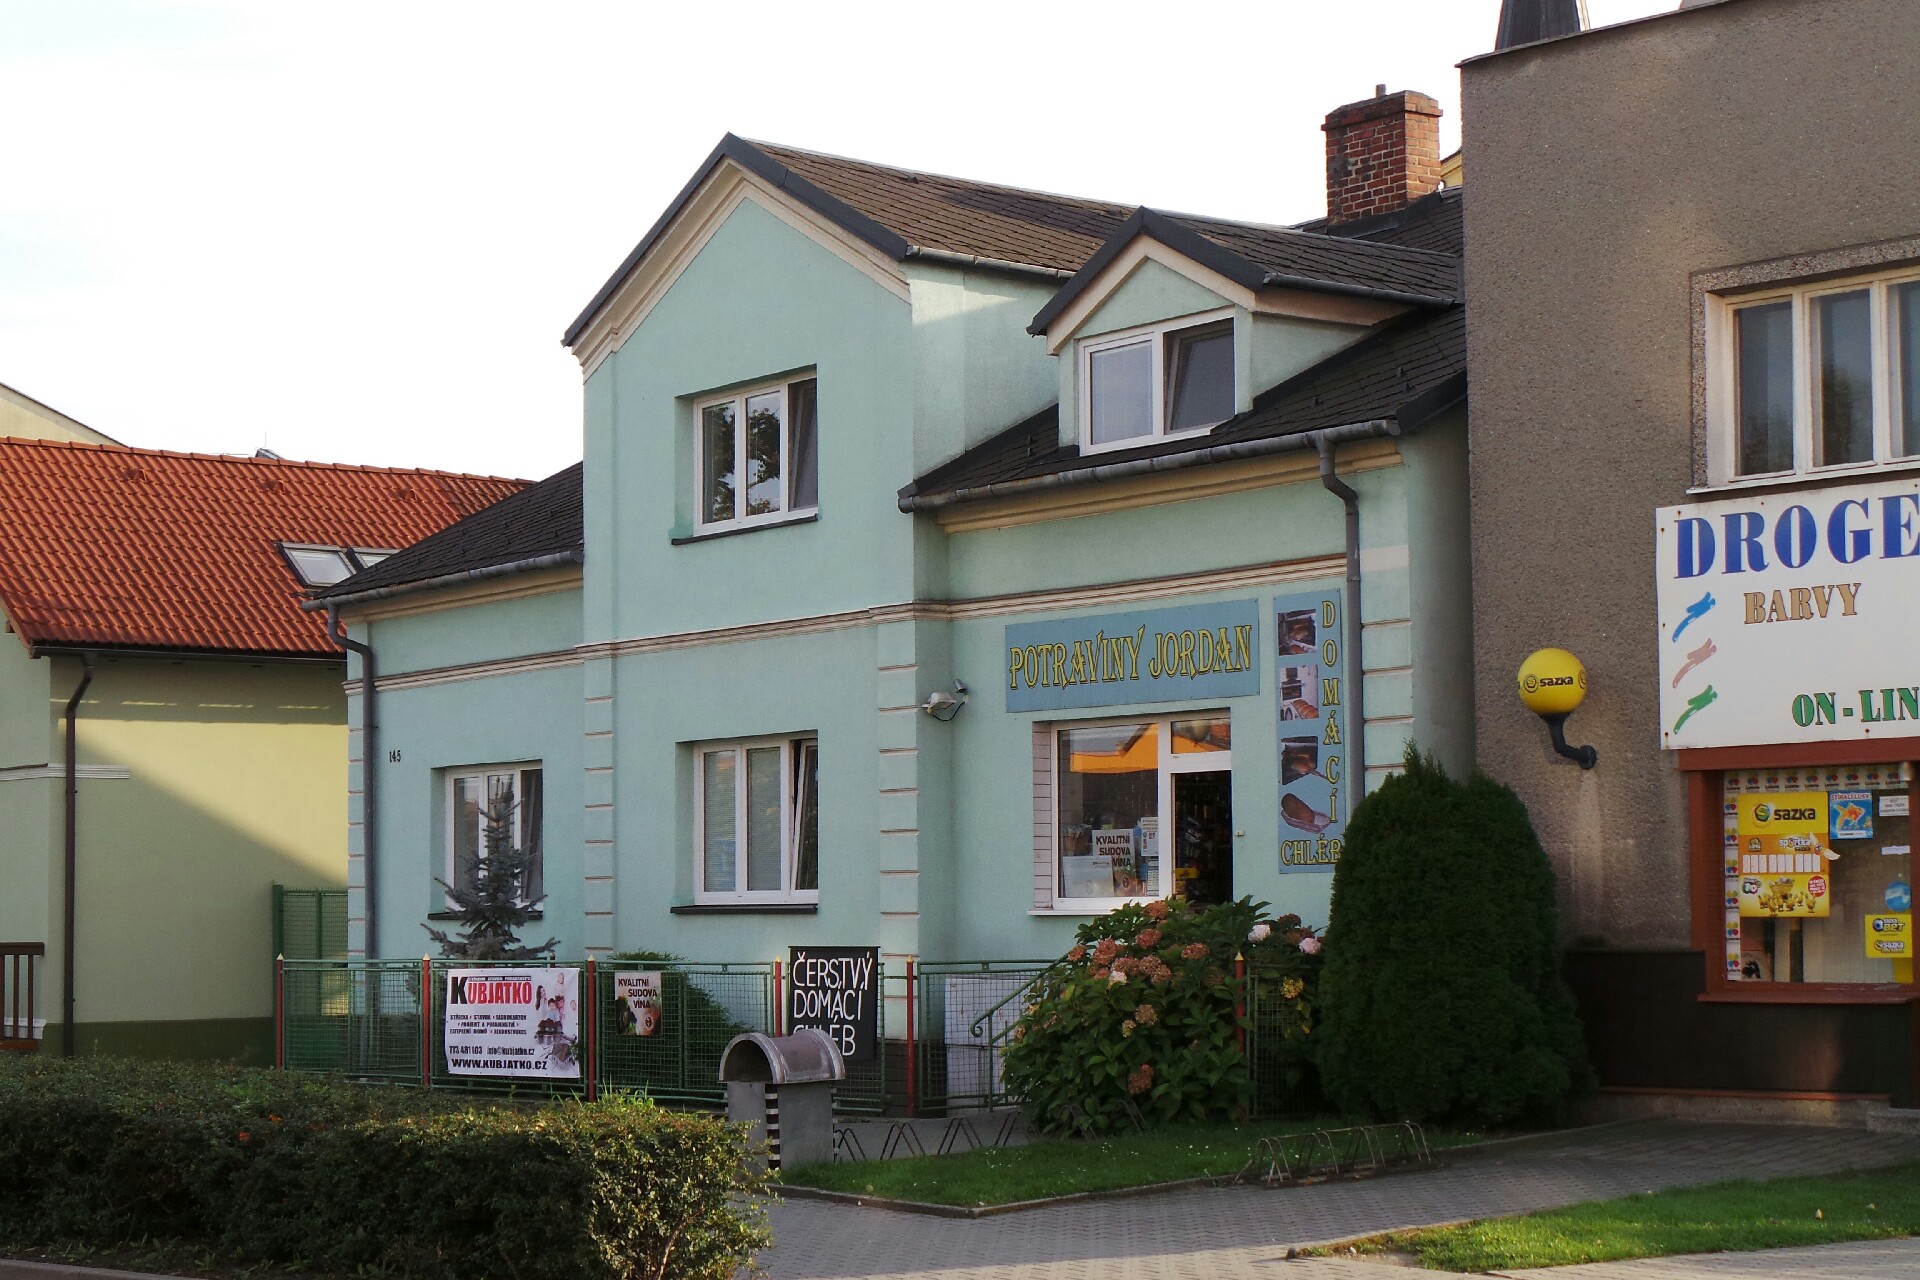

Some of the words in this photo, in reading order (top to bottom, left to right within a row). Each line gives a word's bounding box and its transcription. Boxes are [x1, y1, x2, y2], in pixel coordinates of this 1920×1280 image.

[1674, 494, 1920, 579] DROGE
[1743, 582, 1862, 625] BARVY
[1148, 624, 1252, 680] JORDAN
[388, 749, 402, 763] 145
[1773, 807, 1816, 821] sazka
[1281, 832, 1342, 867] CHLÉB
[792, 950, 873, 991] ČERSTVÝ
[450, 976, 533, 1005] KUBJATKO
[793, 980, 865, 1021] DOMÁCÍ
[451, 1058, 548, 1070] WWW.KUBJATKO.CZ
